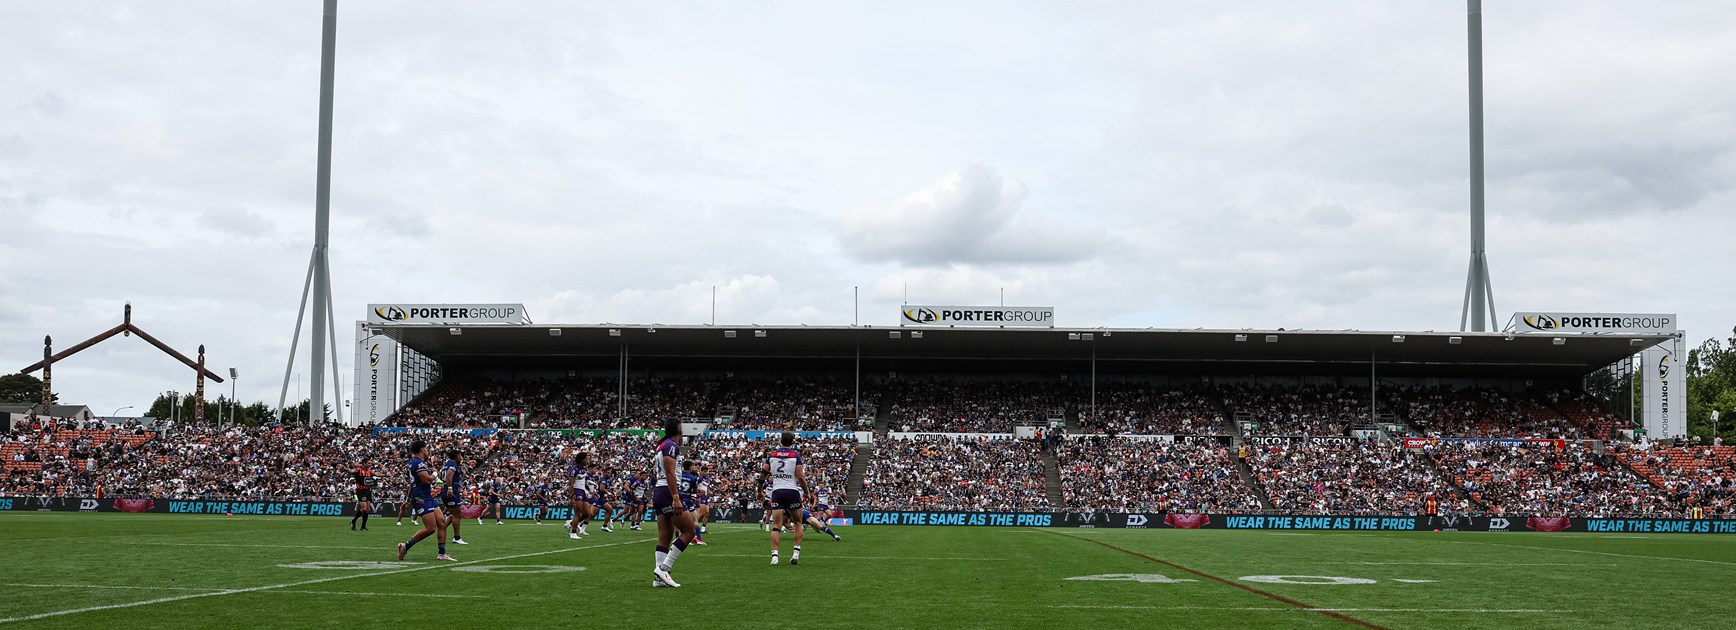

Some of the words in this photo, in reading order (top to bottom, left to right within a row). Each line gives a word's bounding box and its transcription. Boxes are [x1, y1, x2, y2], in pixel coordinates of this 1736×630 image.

[410, 307, 515, 319] PORTERGROUP
[942, 309, 1052, 322] PORTERGROUP
[1561, 316, 1670, 328] PORTERGROUP
[370, 369, 378, 422] PORTERGROU
[1661, 380, 1669, 439] PORTERGROUP
[776, 460, 785, 472] 2
[169, 502, 202, 512] WEAR
[206, 502, 228, 513] THE
[230, 503, 264, 514] SAME
[266, 504, 282, 514] AS
[286, 504, 308, 515] THE
[310, 504, 342, 516] PROS
[546, 508, 570, 518] THE
[861, 512, 898, 524] WEAR
[902, 513, 926, 524] THE
[929, 514, 966, 525] SAME
[968, 514, 986, 525] AS
[988, 514, 1014, 526] THE
[1016, 514, 1051, 526] PROS
[1226, 516, 1264, 528] WEAR
[1267, 517, 1292, 528] THE
[1294, 517, 1331, 529] SAME
[1332, 518, 1350, 529] AS
[1353, 518, 1378, 530] THE
[1380, 518, 1416, 530] PROS
[1587, 520, 1624, 532] WEAR
[1628, 520, 1652, 532] THE
[1654, 520, 1690, 532] SAME
[1692, 521, 1710, 532] AS
[1712, 521, 1736, 532] THE
